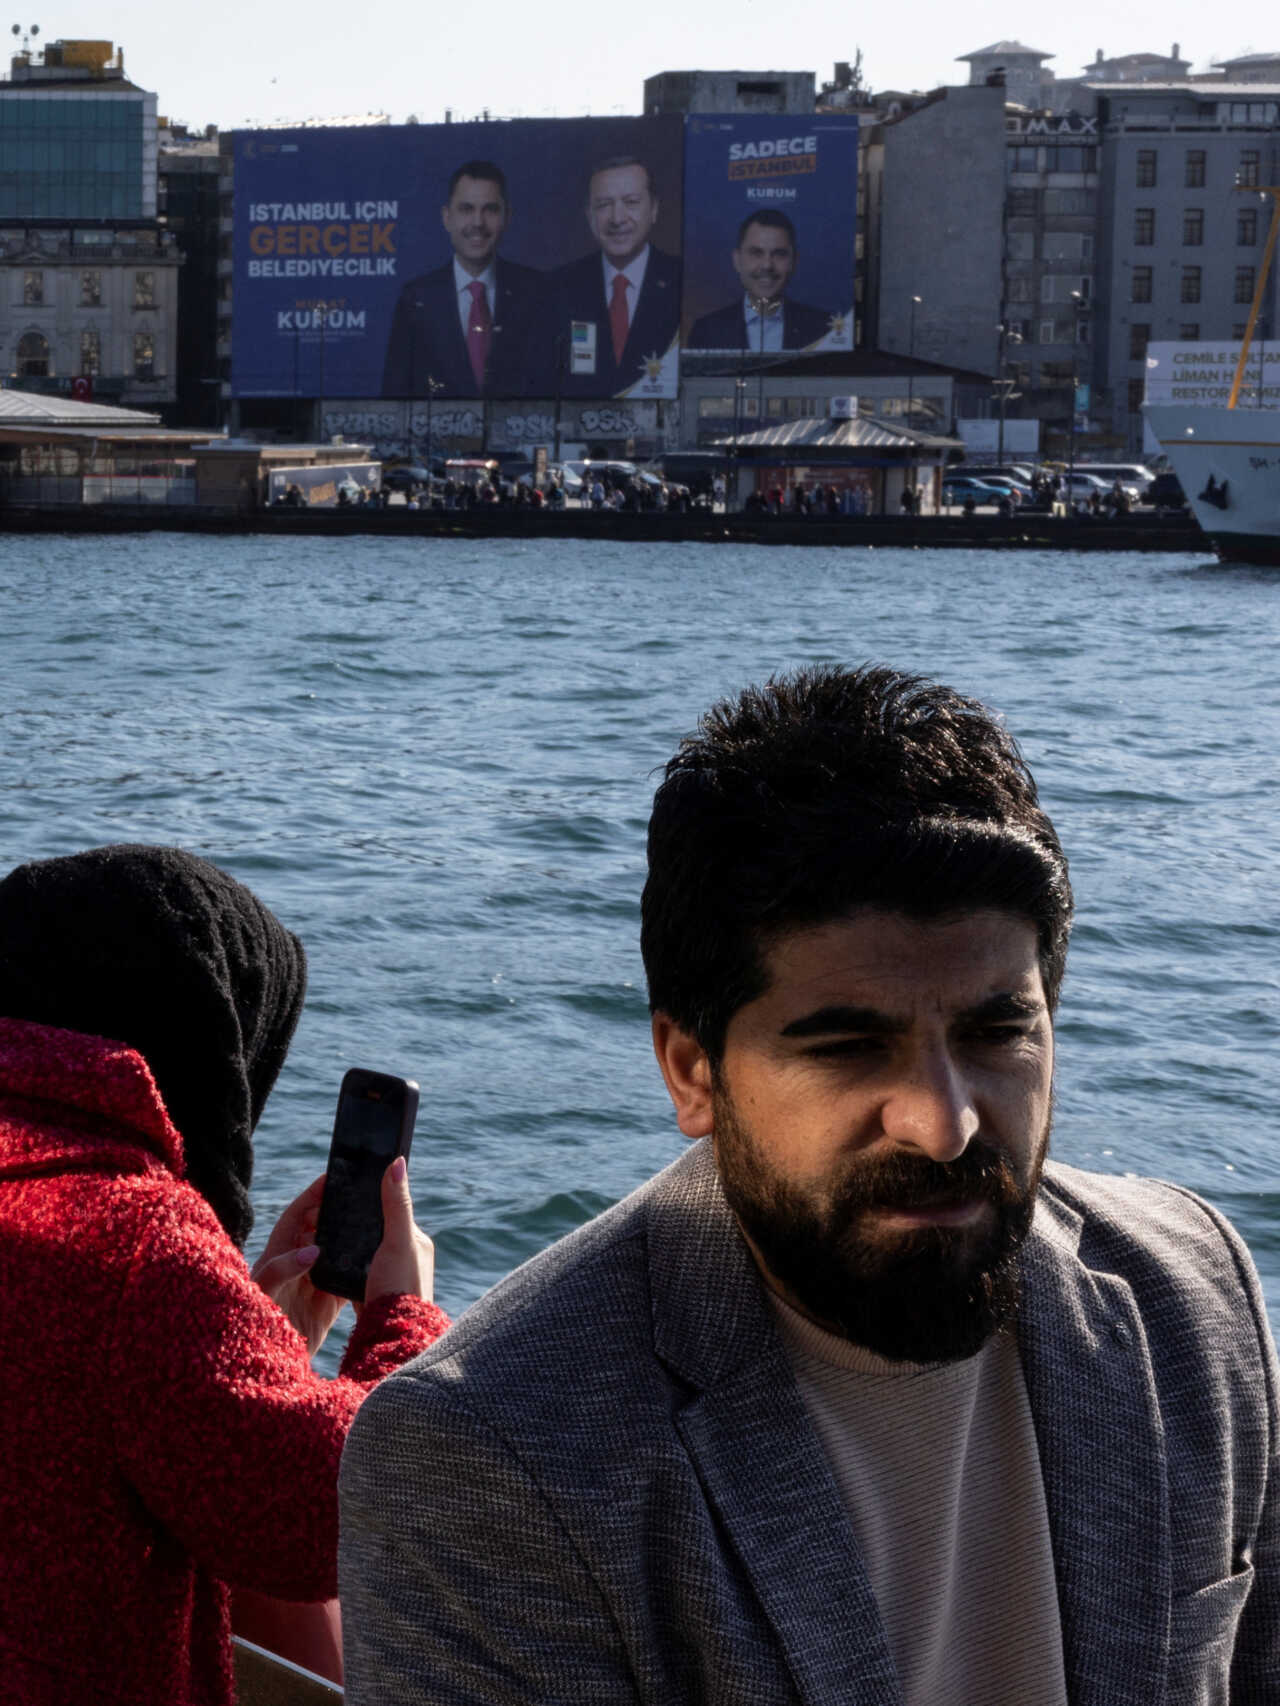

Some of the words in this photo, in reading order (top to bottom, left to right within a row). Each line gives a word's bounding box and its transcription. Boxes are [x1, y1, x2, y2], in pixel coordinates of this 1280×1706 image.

[729, 136, 817, 161] SADECE
[746, 187, 796, 200] KURUM
[249, 223, 397, 257] GERÇEK
[1173, 351, 1227, 364] CEMİLE
[1172, 367, 1219, 382] LİMAN
